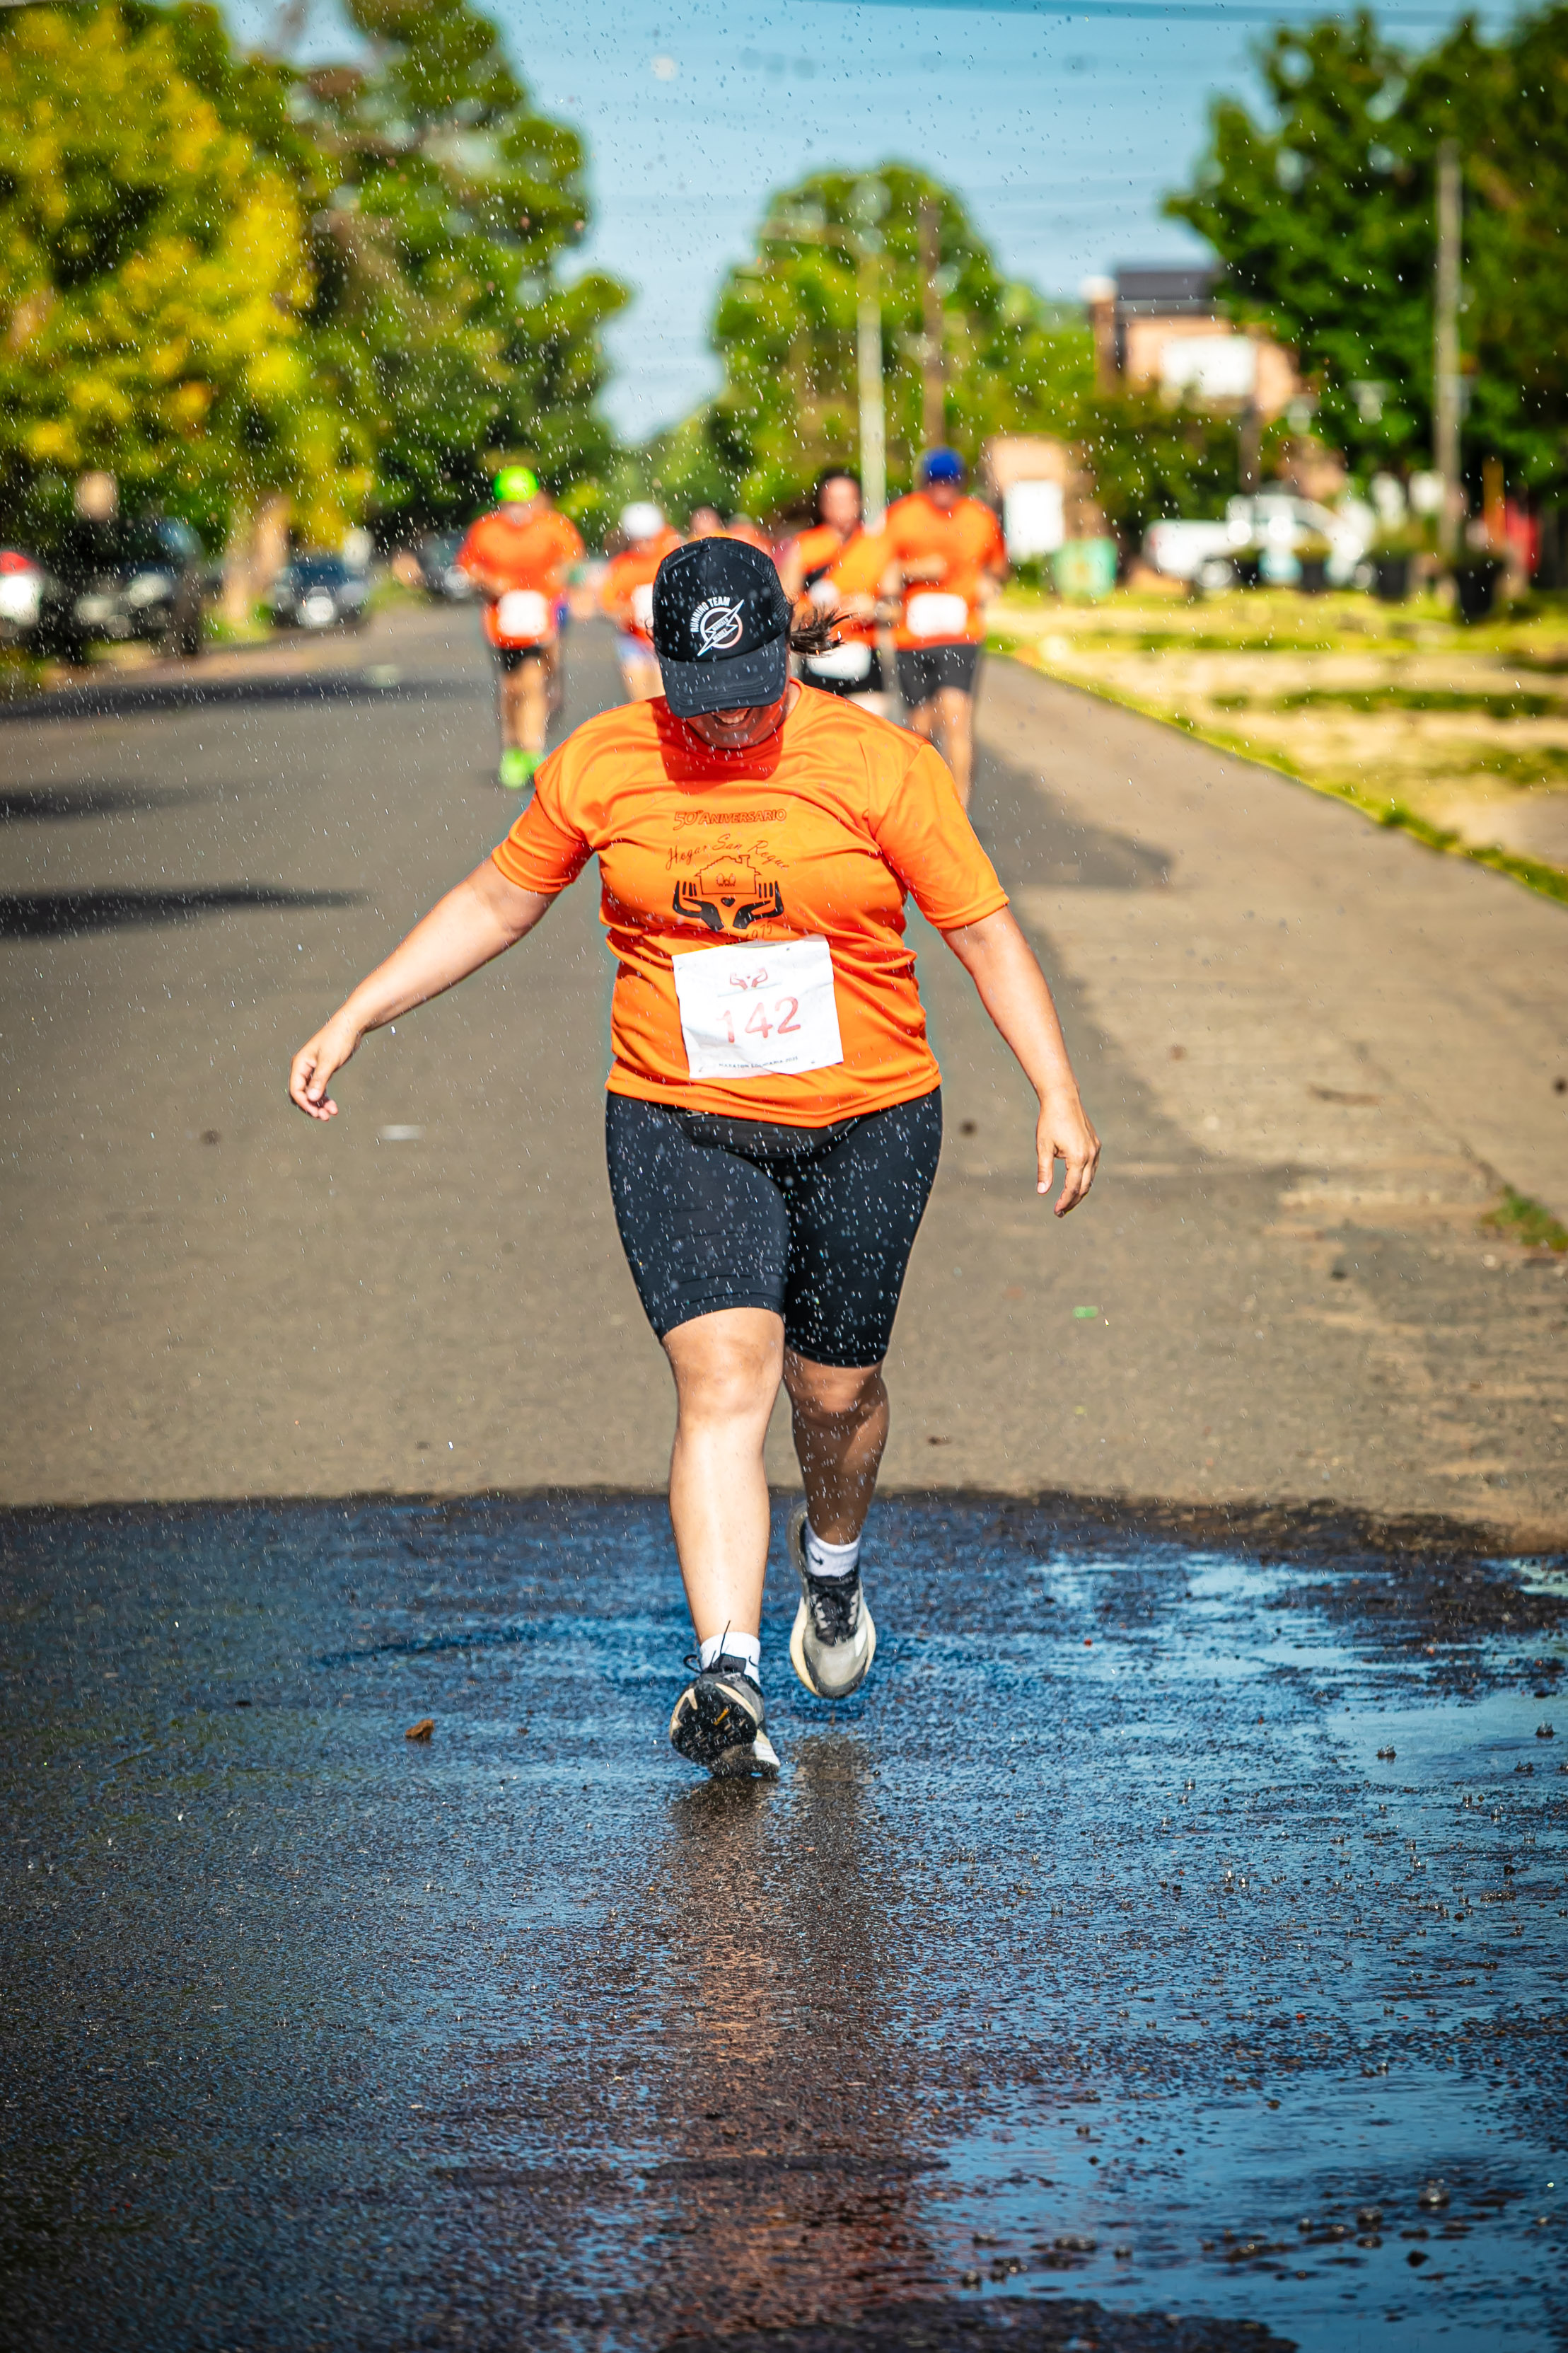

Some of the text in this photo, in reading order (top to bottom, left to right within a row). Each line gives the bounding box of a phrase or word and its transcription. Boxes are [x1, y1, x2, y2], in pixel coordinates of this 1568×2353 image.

[690, 596, 731, 632] RUNNING TEAM
[698, 809, 787, 825] ANIVERSARIO
[666, 833, 790, 871] Hogar San Roque
[716, 997, 801, 1043] 142
